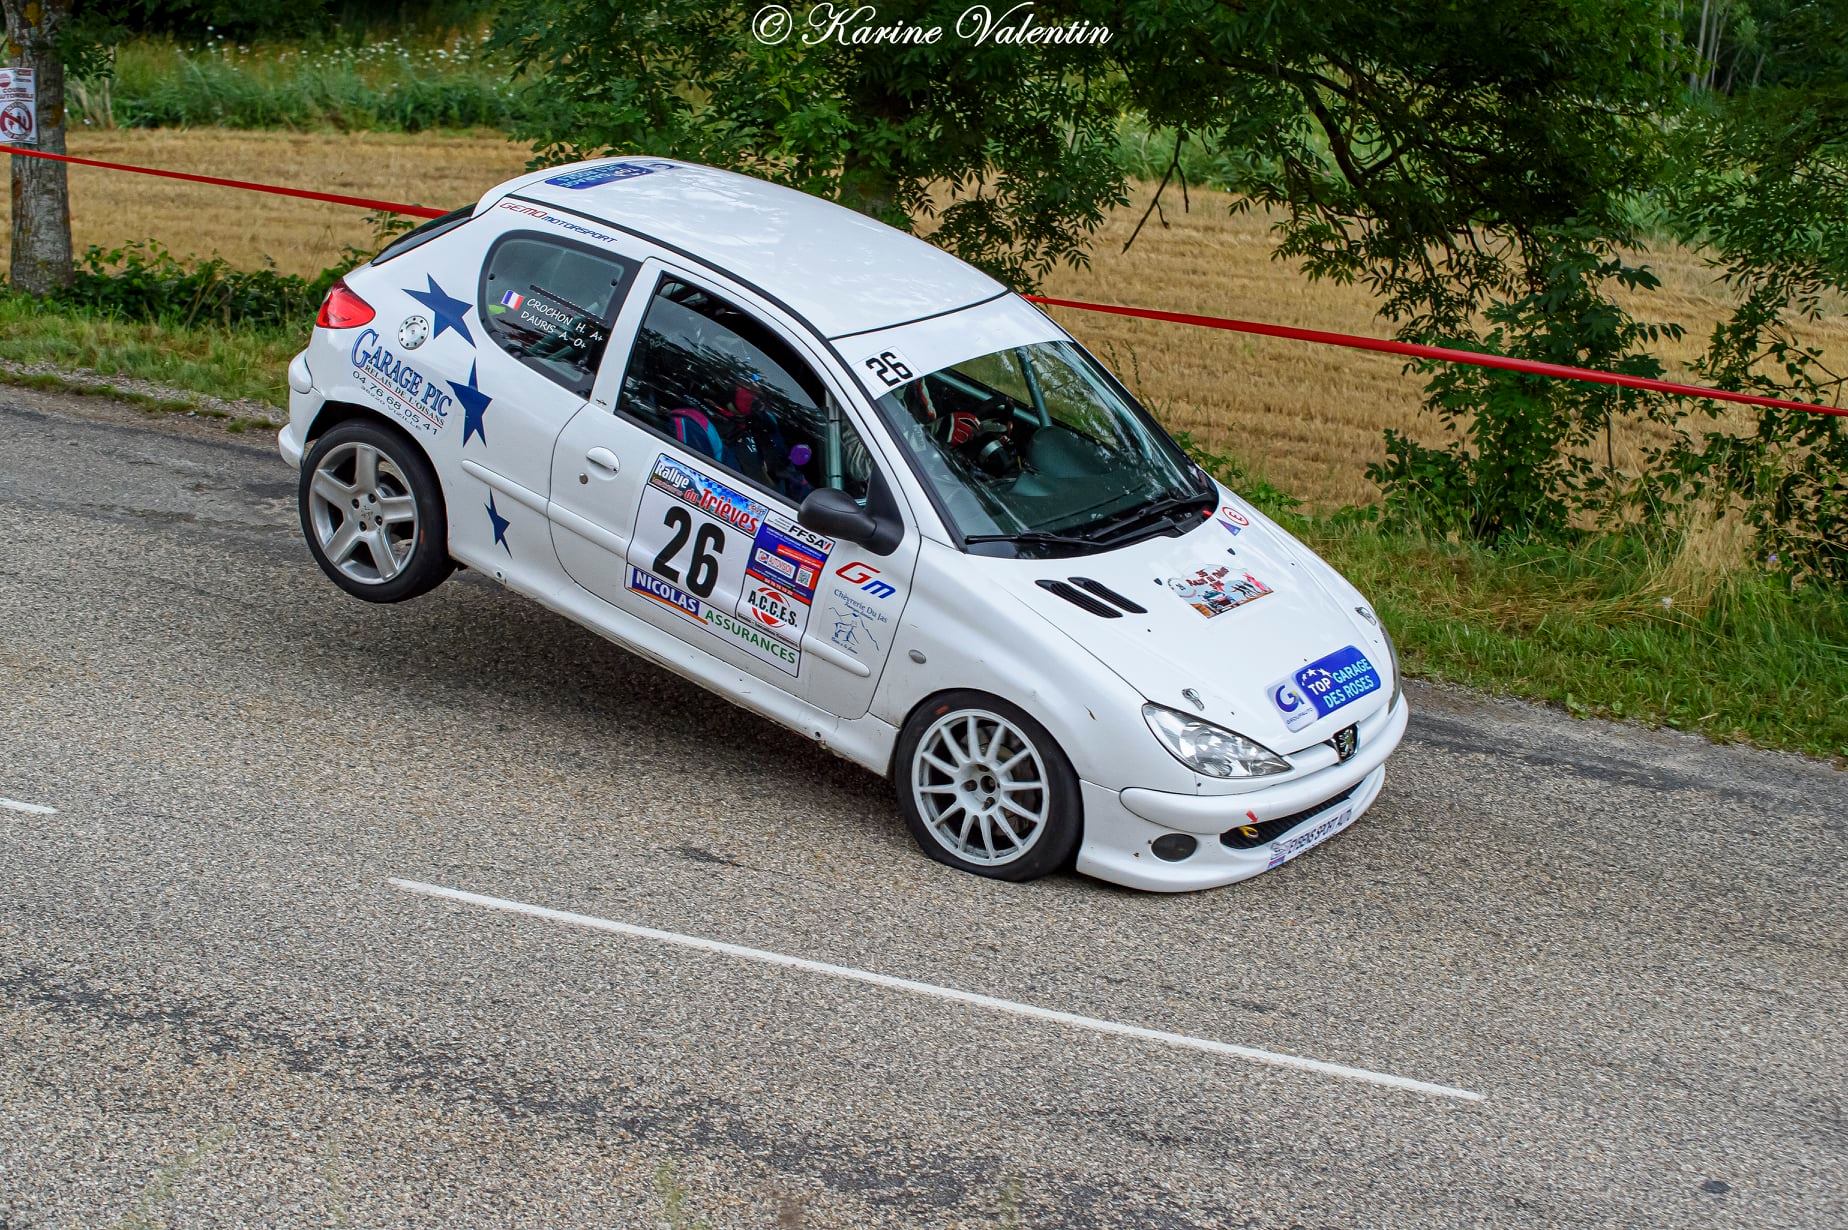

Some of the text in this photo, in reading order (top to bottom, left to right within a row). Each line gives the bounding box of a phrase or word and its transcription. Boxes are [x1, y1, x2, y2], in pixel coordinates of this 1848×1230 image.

[527, 298, 574, 326] CROCHON
[575, 322, 586, 334] H.
[573, 337, 587, 349] O+
[351, 328, 453, 417] GARAGE PIC
[865, 351, 914, 387] 26
[352, 370, 438, 436] 04 76 68 05 41
[364, 364, 445, 427] RELAIS DE L'OISANS
[654, 461, 690, 490] Rallye
[683, 488, 698, 505] du
[699, 488, 760, 536] Trièves
[652, 505, 727, 600] 26
[788, 524, 826, 549] FFSA
[634, 572, 698, 613] NICOLAS
[747, 590, 798, 628] A.C.C.E.S.
[866, 605, 878, 619] Du
[704, 608, 797, 665] ASSURANCES
[1307, 657, 1373, 696] TOP GARAGE
[1322, 674, 1375, 710] DES ROSES
